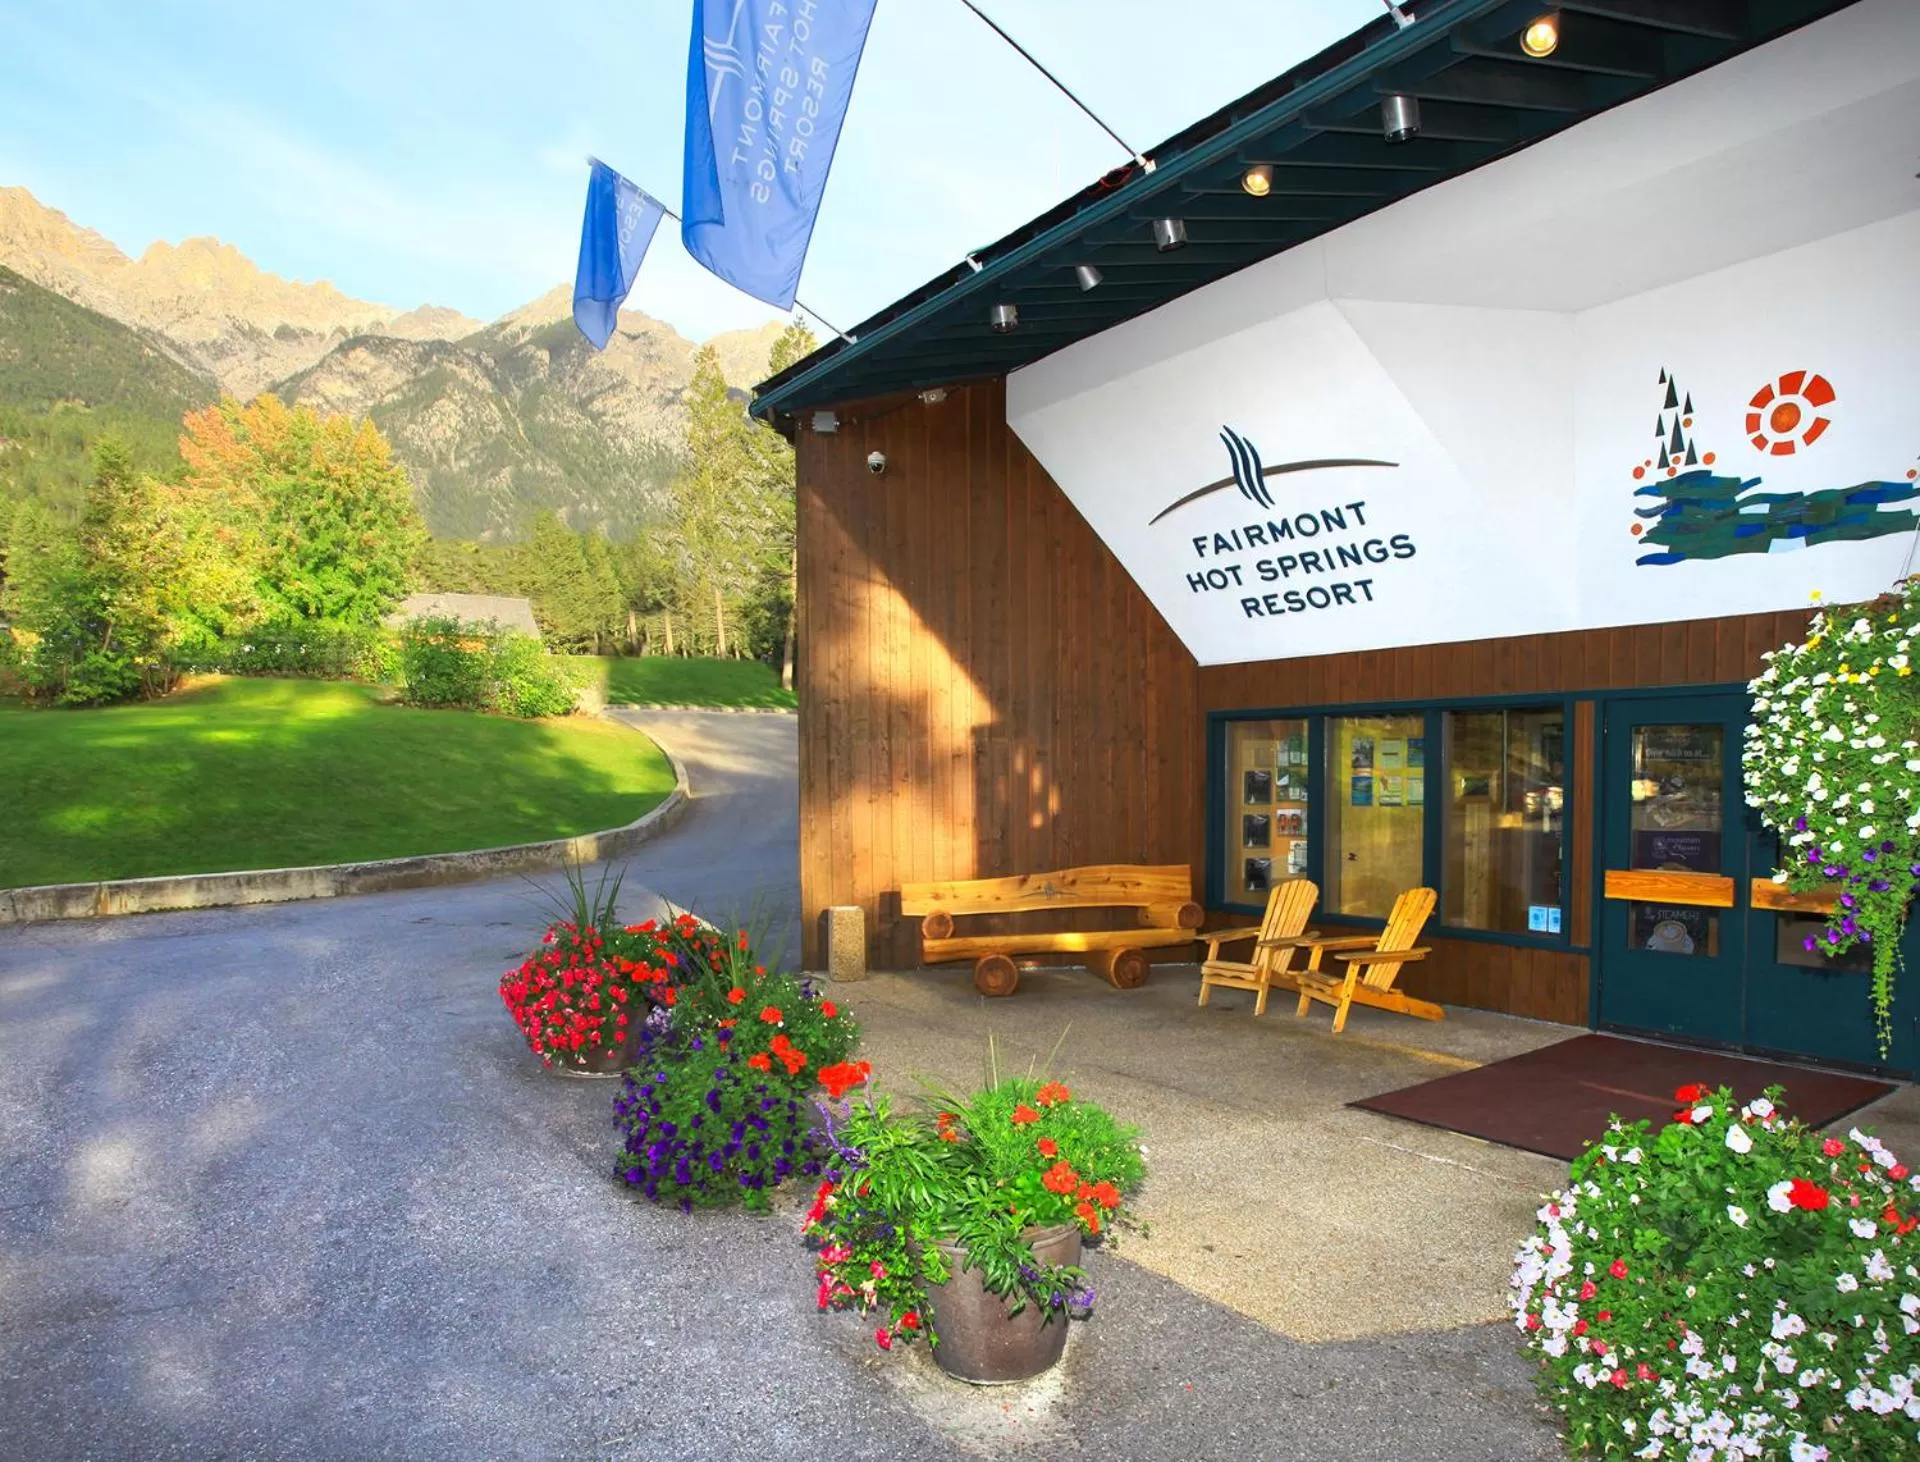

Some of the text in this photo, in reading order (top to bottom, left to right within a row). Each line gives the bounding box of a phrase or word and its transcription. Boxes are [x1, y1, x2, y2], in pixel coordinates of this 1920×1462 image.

[1192, 501, 1366, 557] FAIRMONT
[1185, 533, 1417, 593] HOT SPRINGS
[1240, 578, 1374, 618] RESORT
